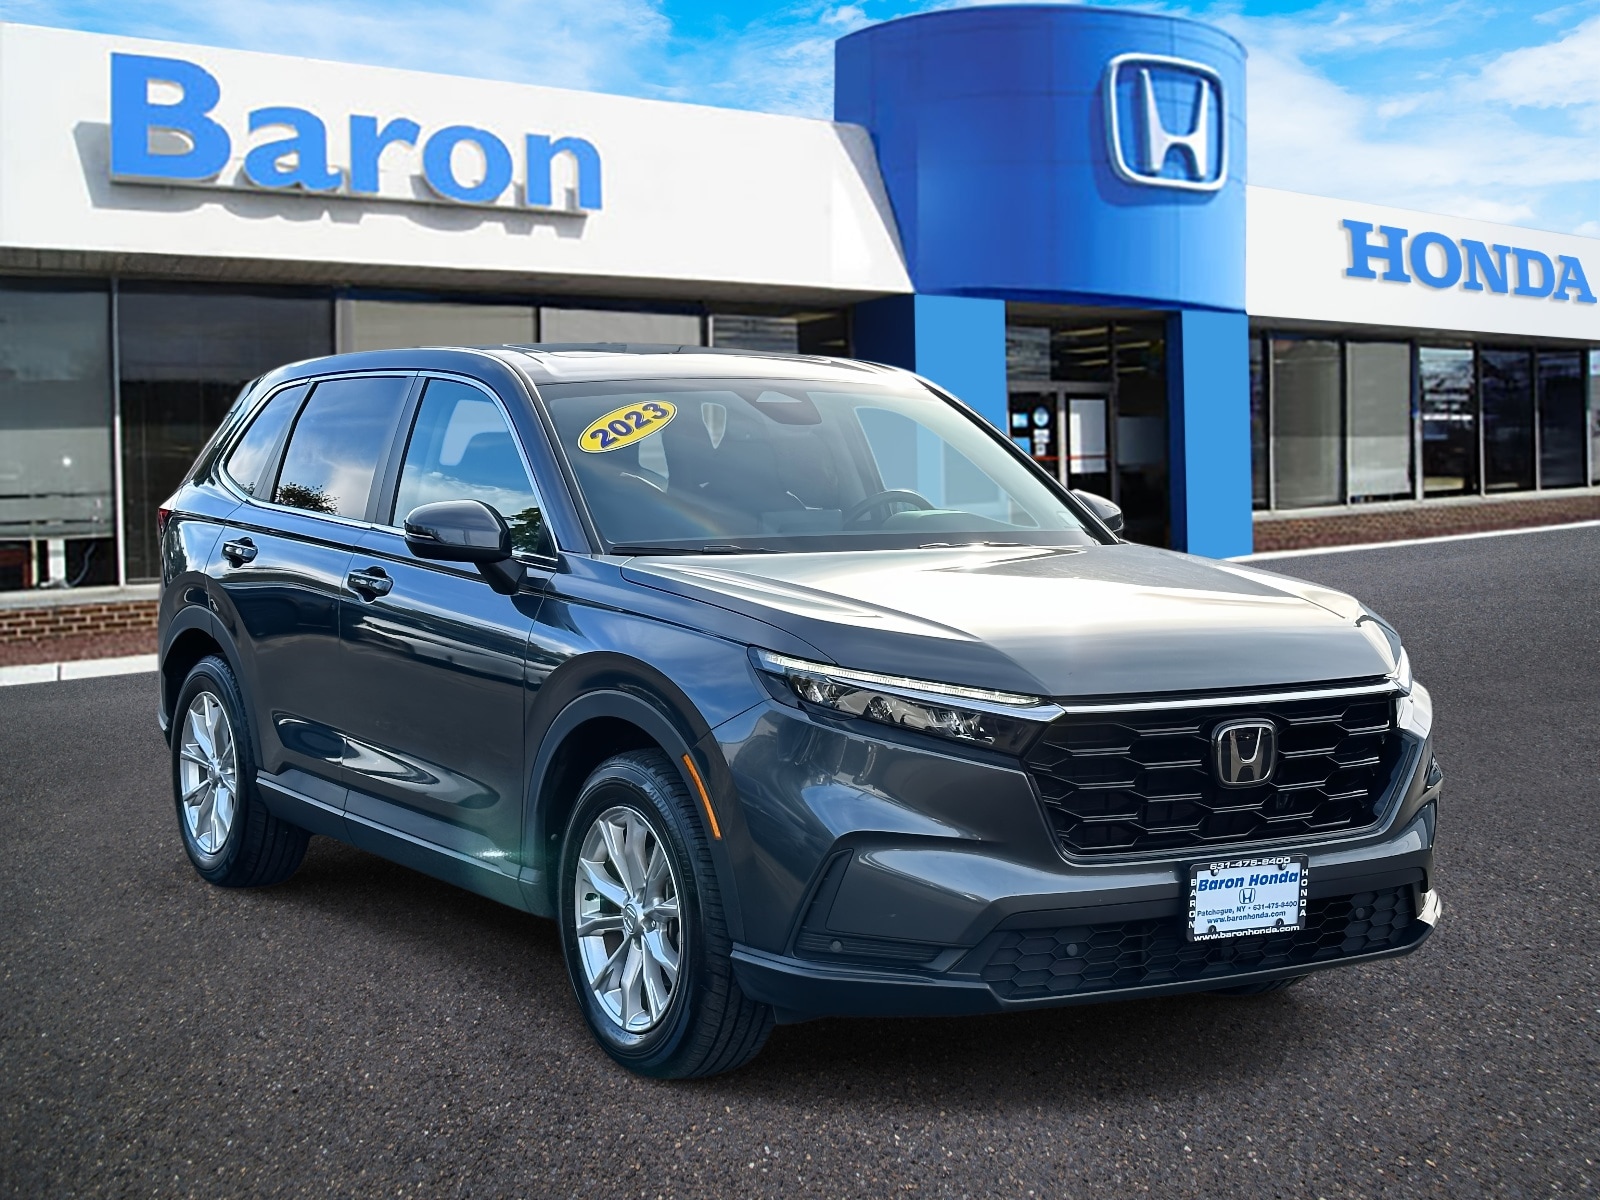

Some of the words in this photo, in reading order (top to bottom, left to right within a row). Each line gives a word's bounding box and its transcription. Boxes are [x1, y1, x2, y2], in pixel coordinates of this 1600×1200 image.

[110, 52, 603, 212] Baron
[1341, 218, 1598, 304] HONDA
[590, 402, 670, 450] 2023
[1209, 857, 1291, 871] 631-475-8400
[1197, 878, 1245, 892] Baron
[1249, 871, 1299, 887] Honda
[1299, 869, 1309, 916] HONDA
[1207, 911, 1286, 924] www.baronhonda.com
[1236, 905, 1246, 913] NY
[1193, 925, 1300, 942] www.baronhonda.com
